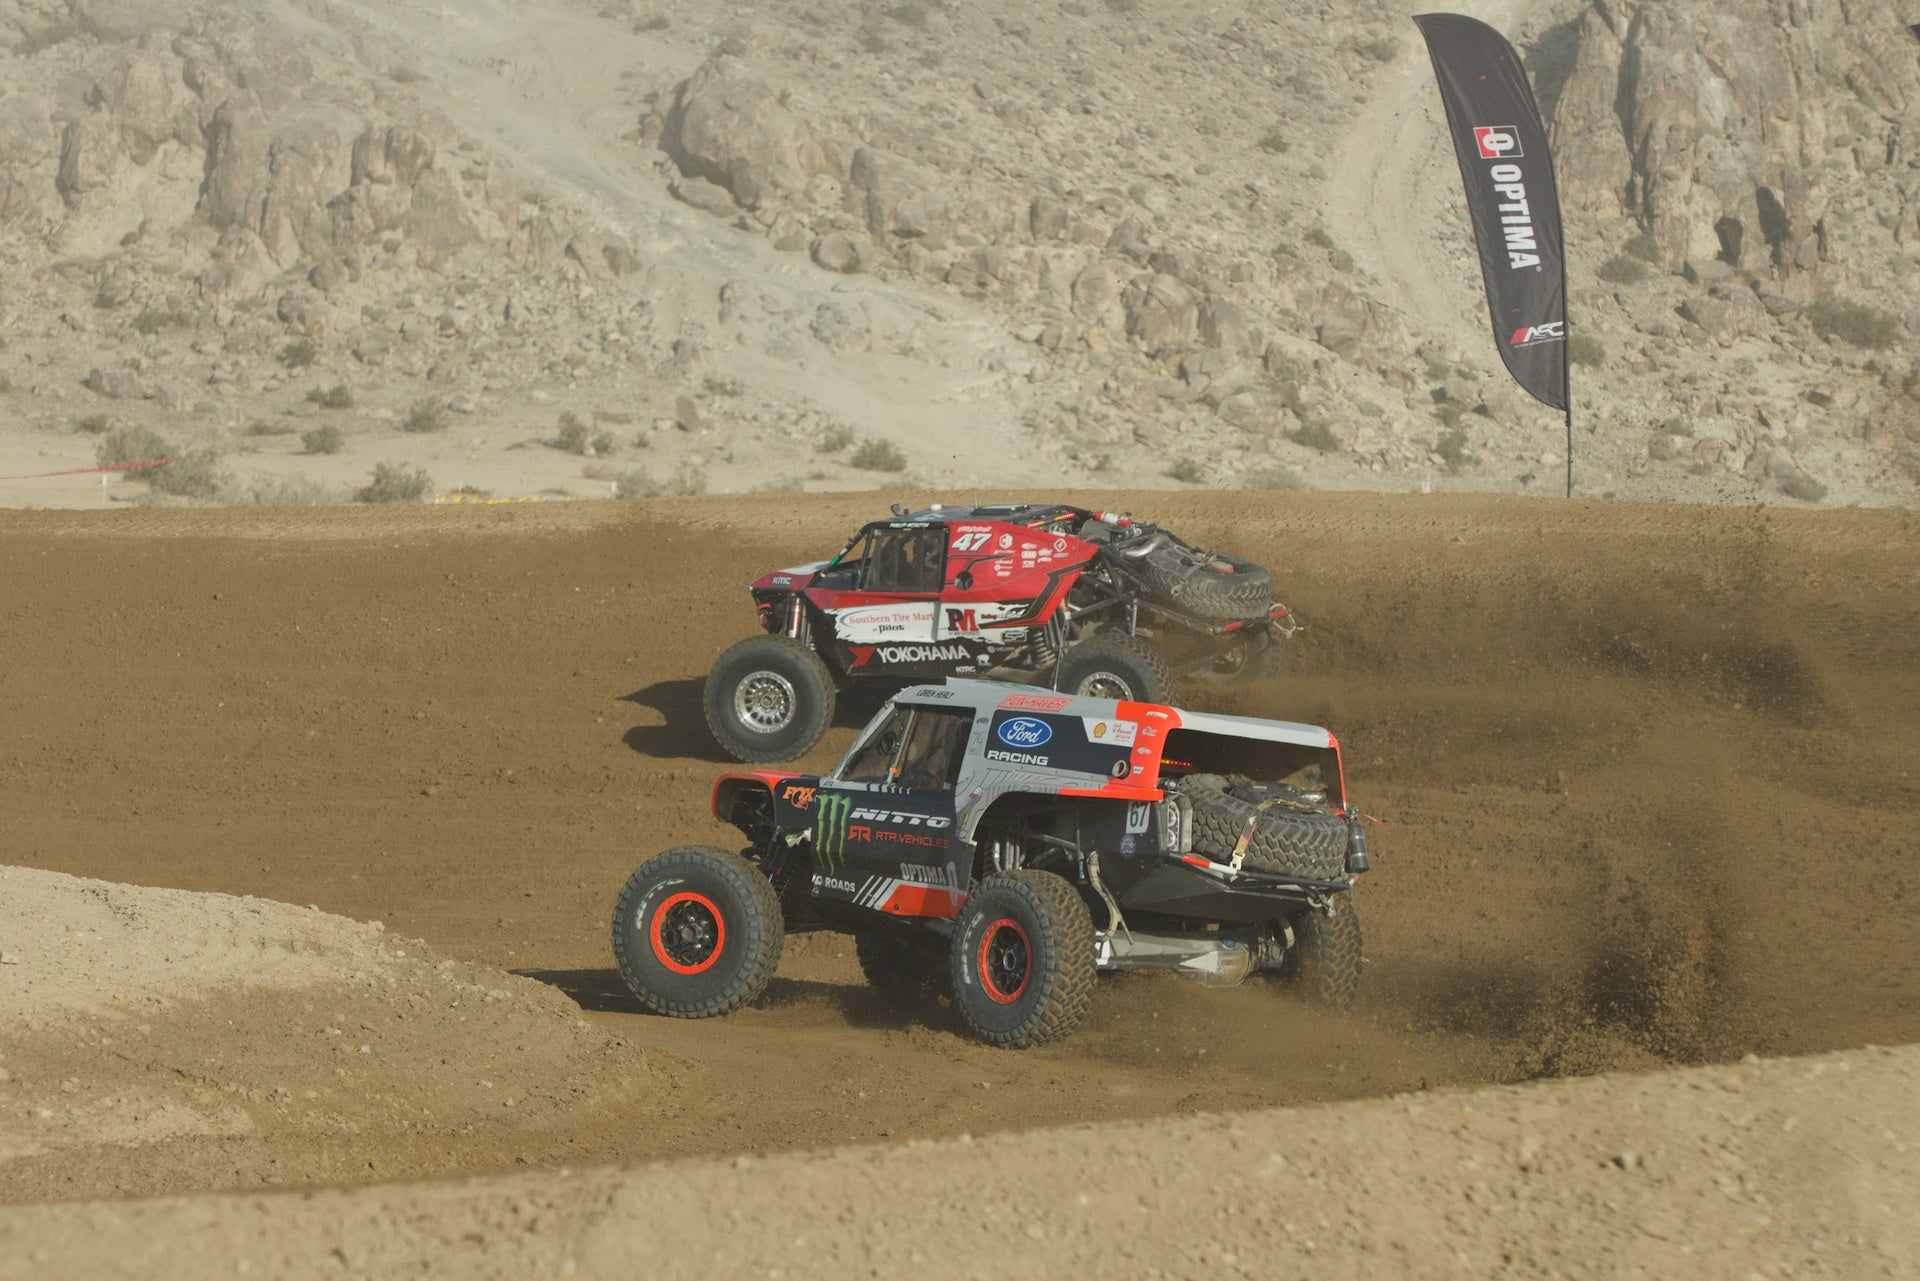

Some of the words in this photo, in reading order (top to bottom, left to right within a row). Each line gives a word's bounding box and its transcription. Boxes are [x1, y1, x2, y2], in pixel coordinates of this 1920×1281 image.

[1490, 163, 1541, 270] OPTIMA
[951, 533, 993, 551] 47
[849, 615, 890, 625] Southern
[892, 613, 911, 623] Tire
[913, 612, 935, 622] Mart
[879, 624, 905, 634] pilot
[876, 645, 971, 664] YOKOHAMA
[1007, 720, 1043, 743] Ford
[987, 750, 1049, 766] RACING
[782, 786, 817, 808] FOX
[850, 807, 951, 829] NITTO
[1129, 801, 1148, 828] 67
[875, 830, 897, 842] RTR
[899, 832, 950, 848] VEHICLES
[900, 862, 947, 885] OPTIMA
[824, 877, 856, 892] ROADS
